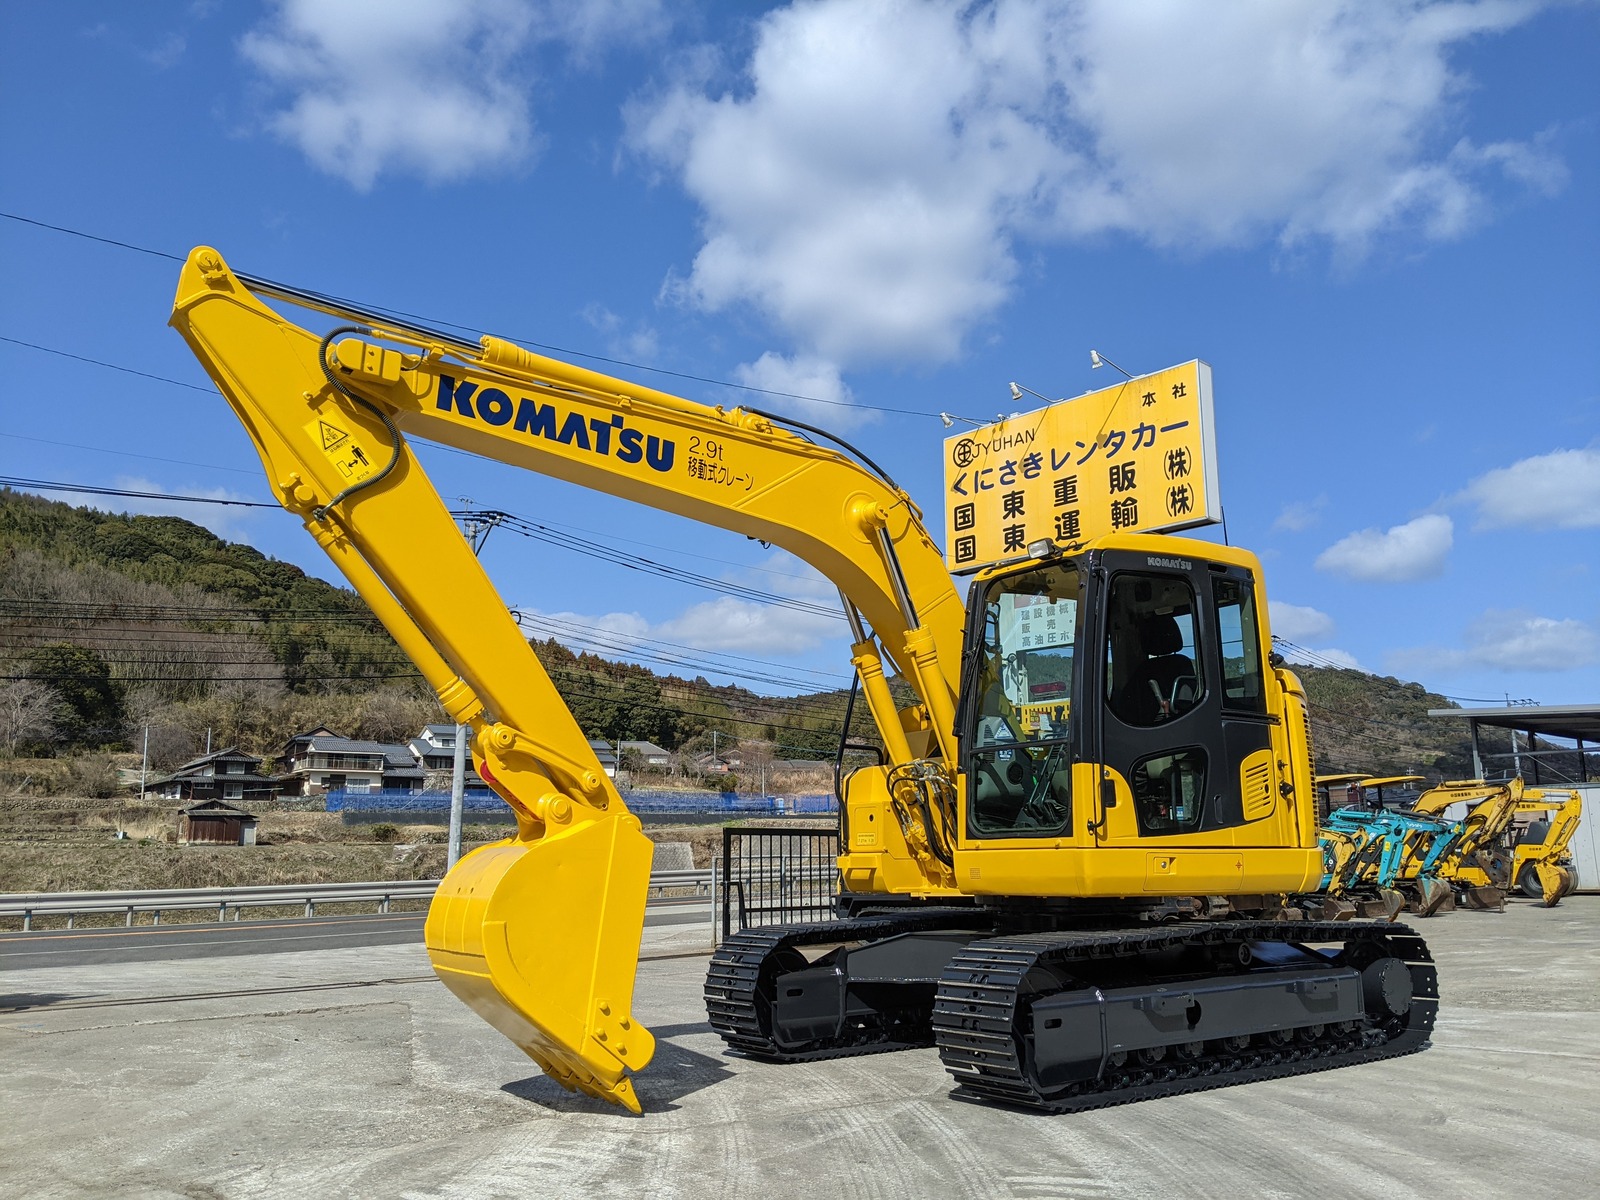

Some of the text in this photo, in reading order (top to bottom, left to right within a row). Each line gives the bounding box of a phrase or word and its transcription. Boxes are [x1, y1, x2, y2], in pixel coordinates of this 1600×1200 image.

[1142, 382, 1187, 407] 本社
[436, 373, 675, 473] KOMATSU
[689, 436, 723, 461] 2.9t
[953, 420, 1189, 496] くにさきレンタカー
[972, 428, 1035, 459] JYUHAN
[688, 456, 754, 491] 移動式クレーン
[1147, 556, 1192, 571] KOMATSU
